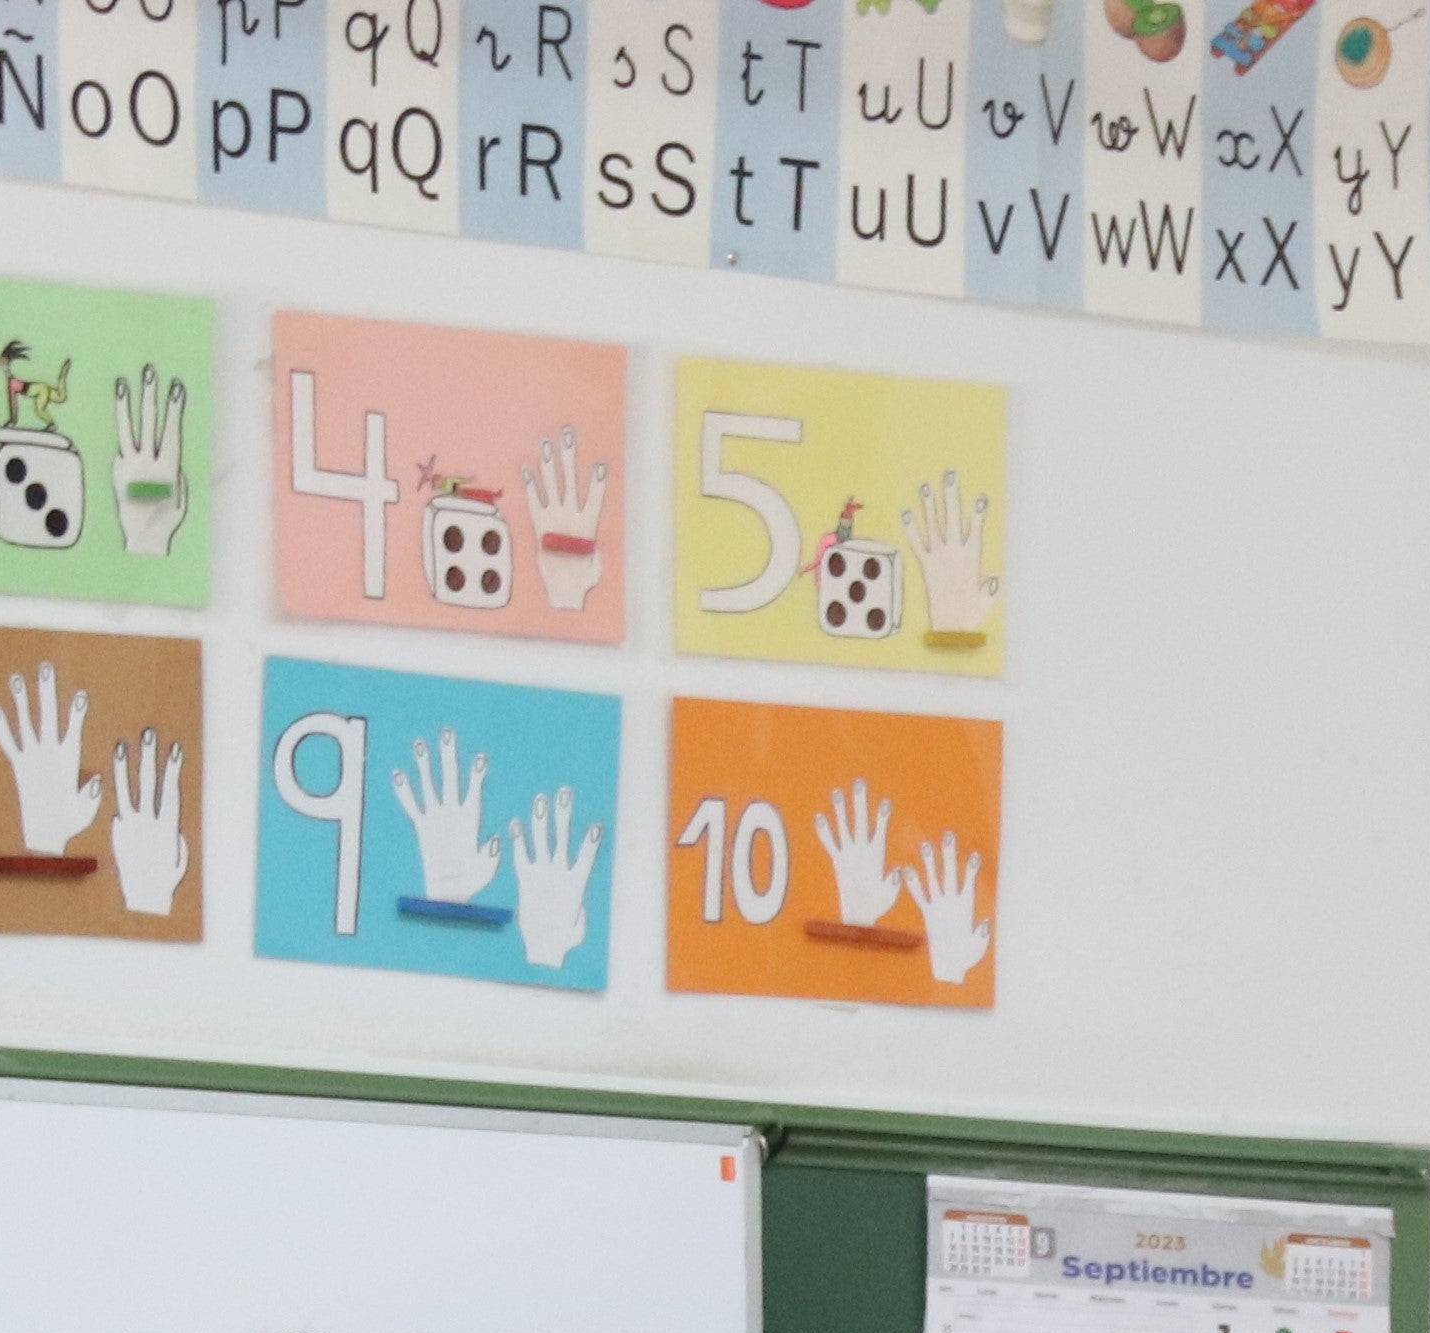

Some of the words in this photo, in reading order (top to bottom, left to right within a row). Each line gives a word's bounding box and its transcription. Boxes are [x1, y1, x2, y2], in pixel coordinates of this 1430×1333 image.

[71, 70, 180, 146] oO
[213, 88, 311, 173] pP
[339, 107, 443, 200] qQ
[477, 123, 562, 201] rR
[598, 141, 697, 217] sS
[729, 156, 820, 231] tT
[851, 173, 948, 247] uU
[980, 188, 1070, 261] vV
[1092, 200, 1194, 275] wW
[1216, 217, 1300, 291] xX
[1329, 232, 1414, 310] yY
[289, 369, 400, 600] 4
[698, 410, 805, 615] 5
[272, 711, 367, 936] 9
[677, 796, 790, 924] 10
[1062, 1254, 1255, 1291] Septiembre
[1135, 1232, 1187, 1252] 2023
